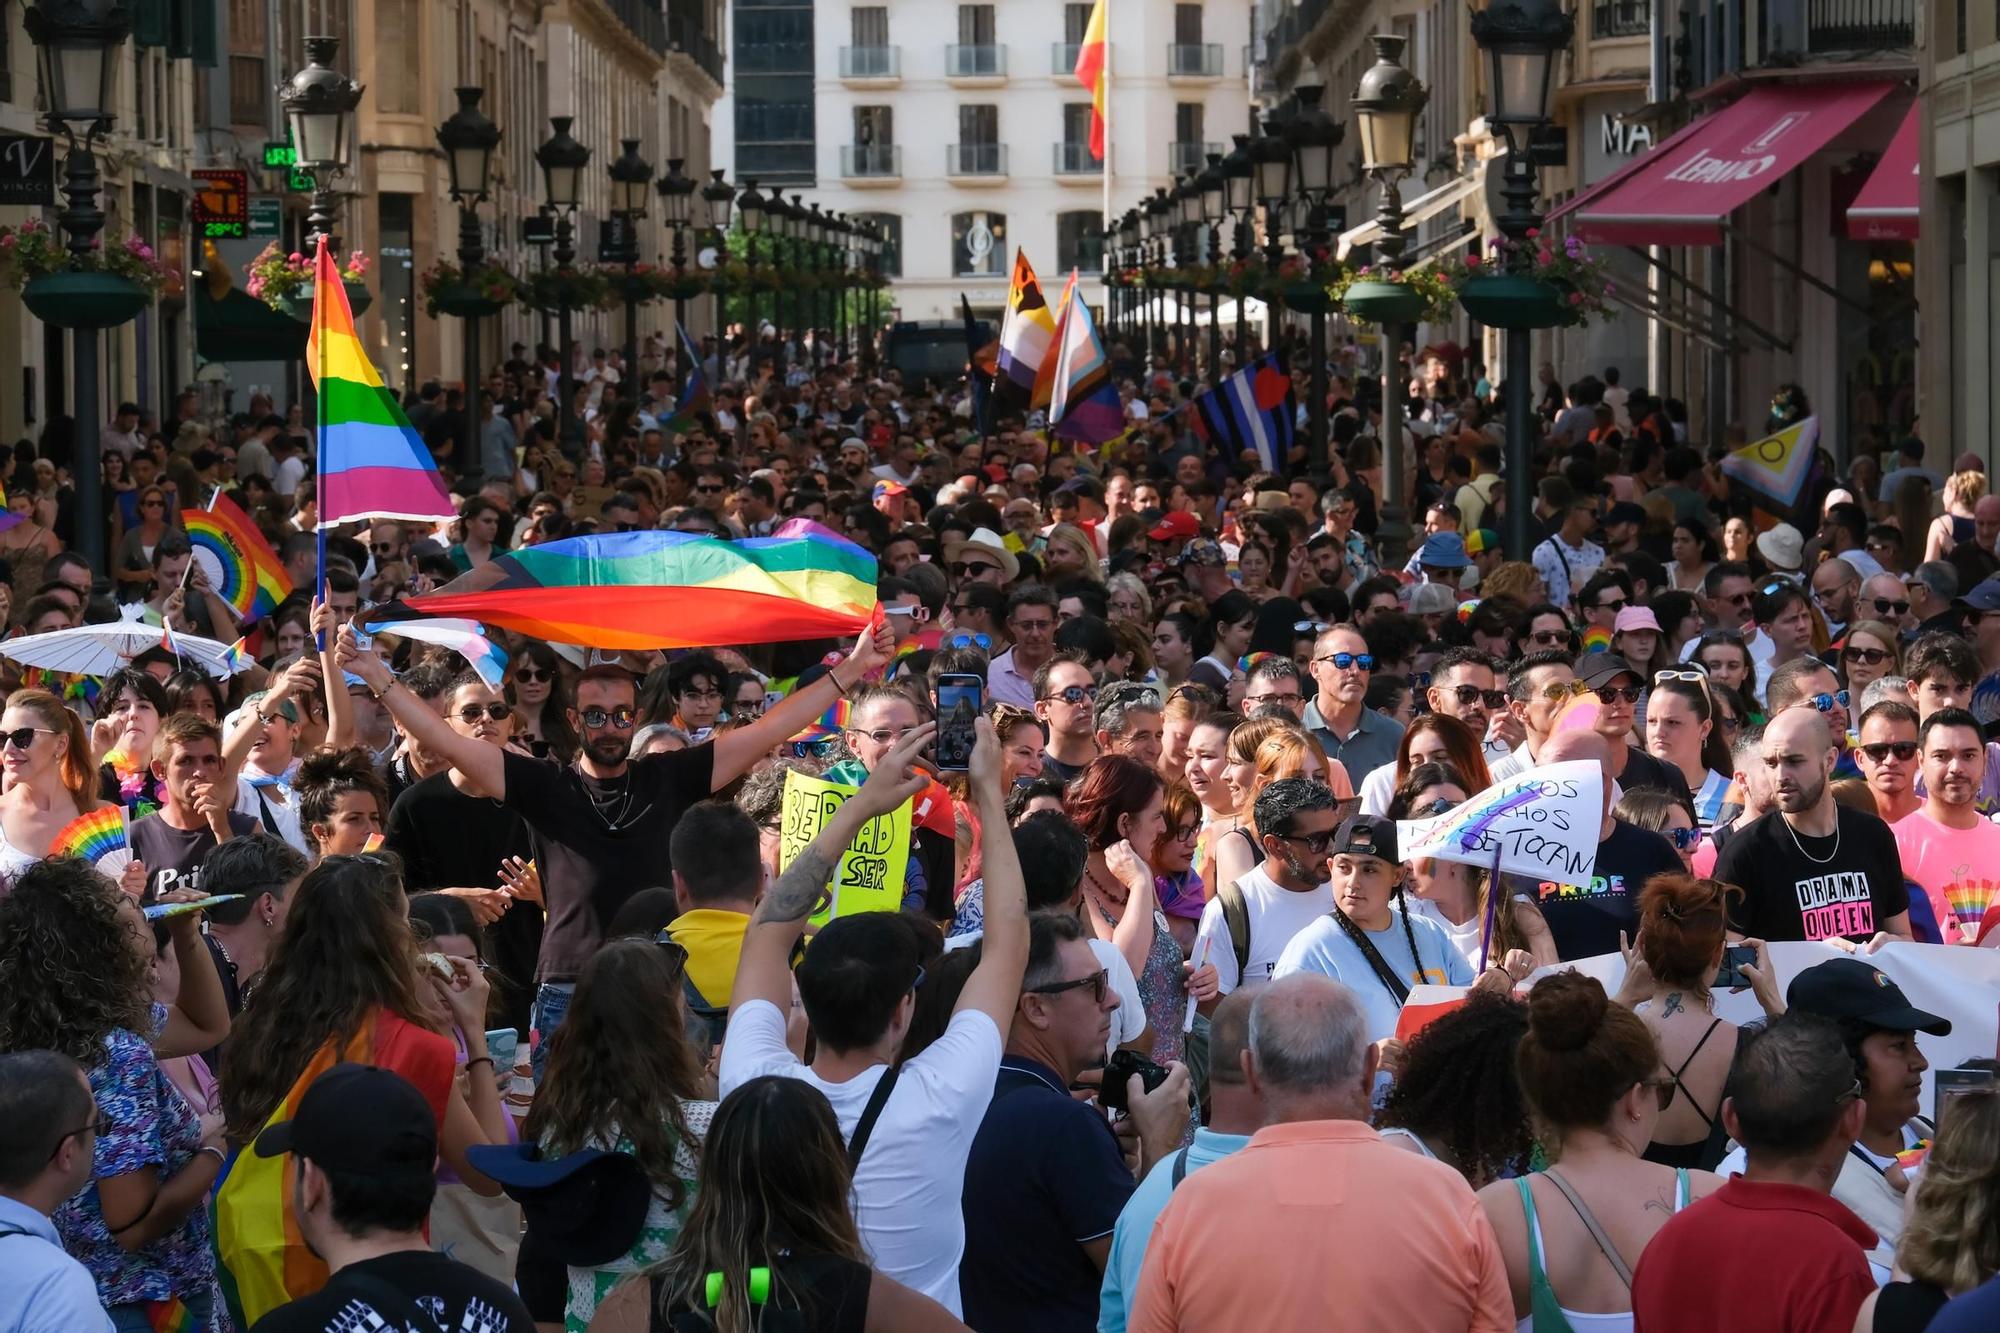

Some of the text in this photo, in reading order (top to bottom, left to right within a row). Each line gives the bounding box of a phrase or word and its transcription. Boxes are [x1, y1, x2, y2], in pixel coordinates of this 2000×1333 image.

[5, 139, 44, 177] V
[3, 183, 48, 192] VINCCI
[1506, 828, 1594, 875] TOCAN
[841, 856, 888, 890] SER
[1798, 873, 1868, 907] DRAMA
[1804, 905, 1872, 938] QUEEN
